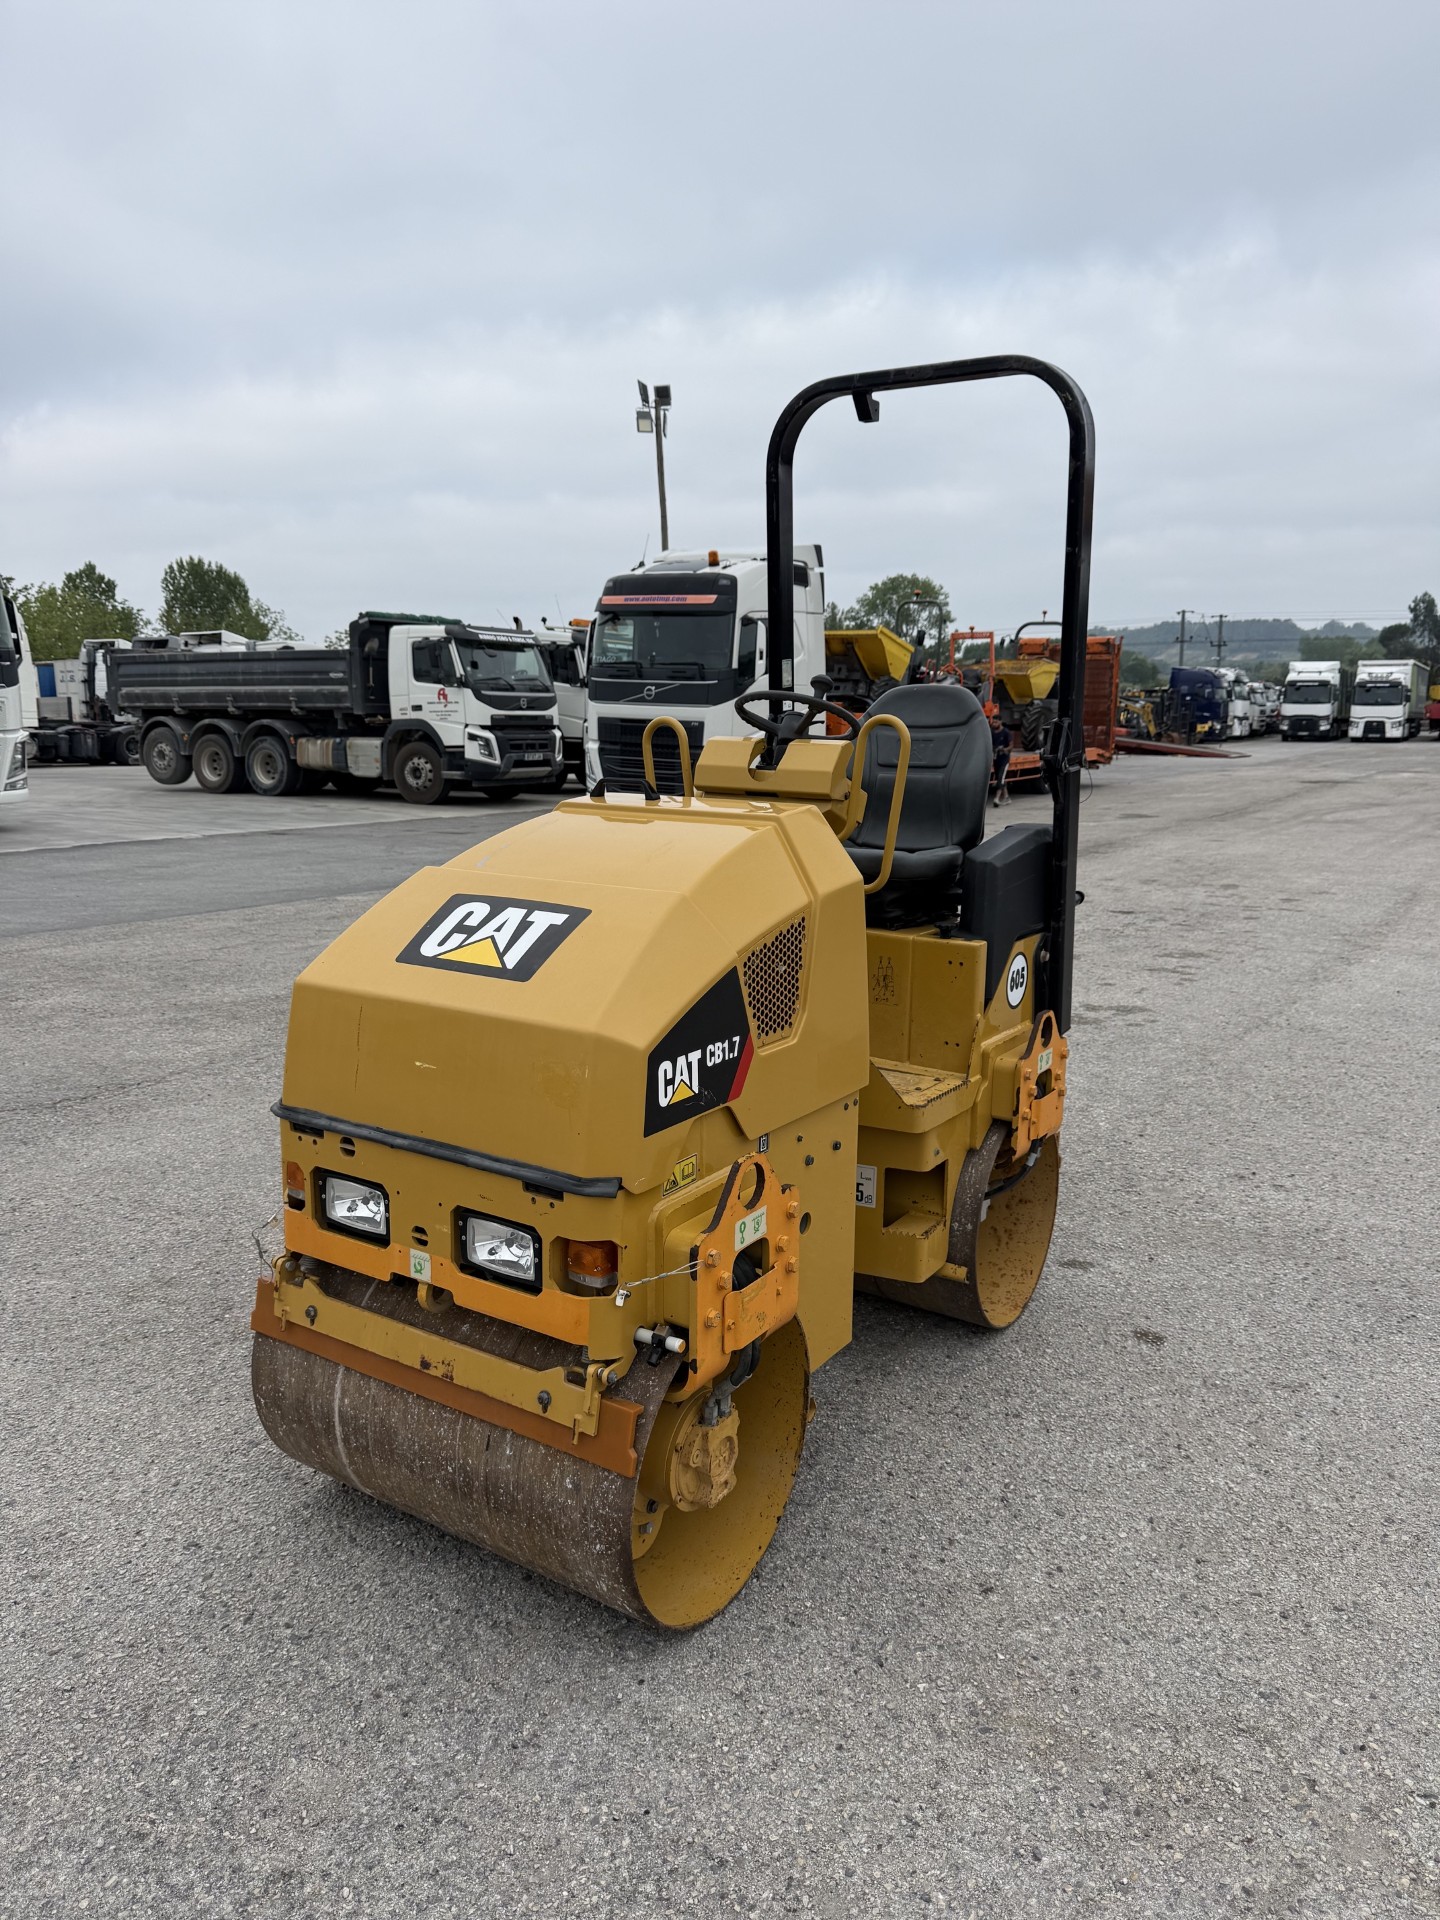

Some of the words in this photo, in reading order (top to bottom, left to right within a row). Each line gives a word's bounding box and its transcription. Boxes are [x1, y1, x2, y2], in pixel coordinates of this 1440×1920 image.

[420, 901, 570, 970] CAT
[1010, 966, 1025, 992] 605
[658, 1049, 702, 1108] CAT
[706, 1036, 740, 1068] CB1.7
[864, 1194, 873, 1204] dB
